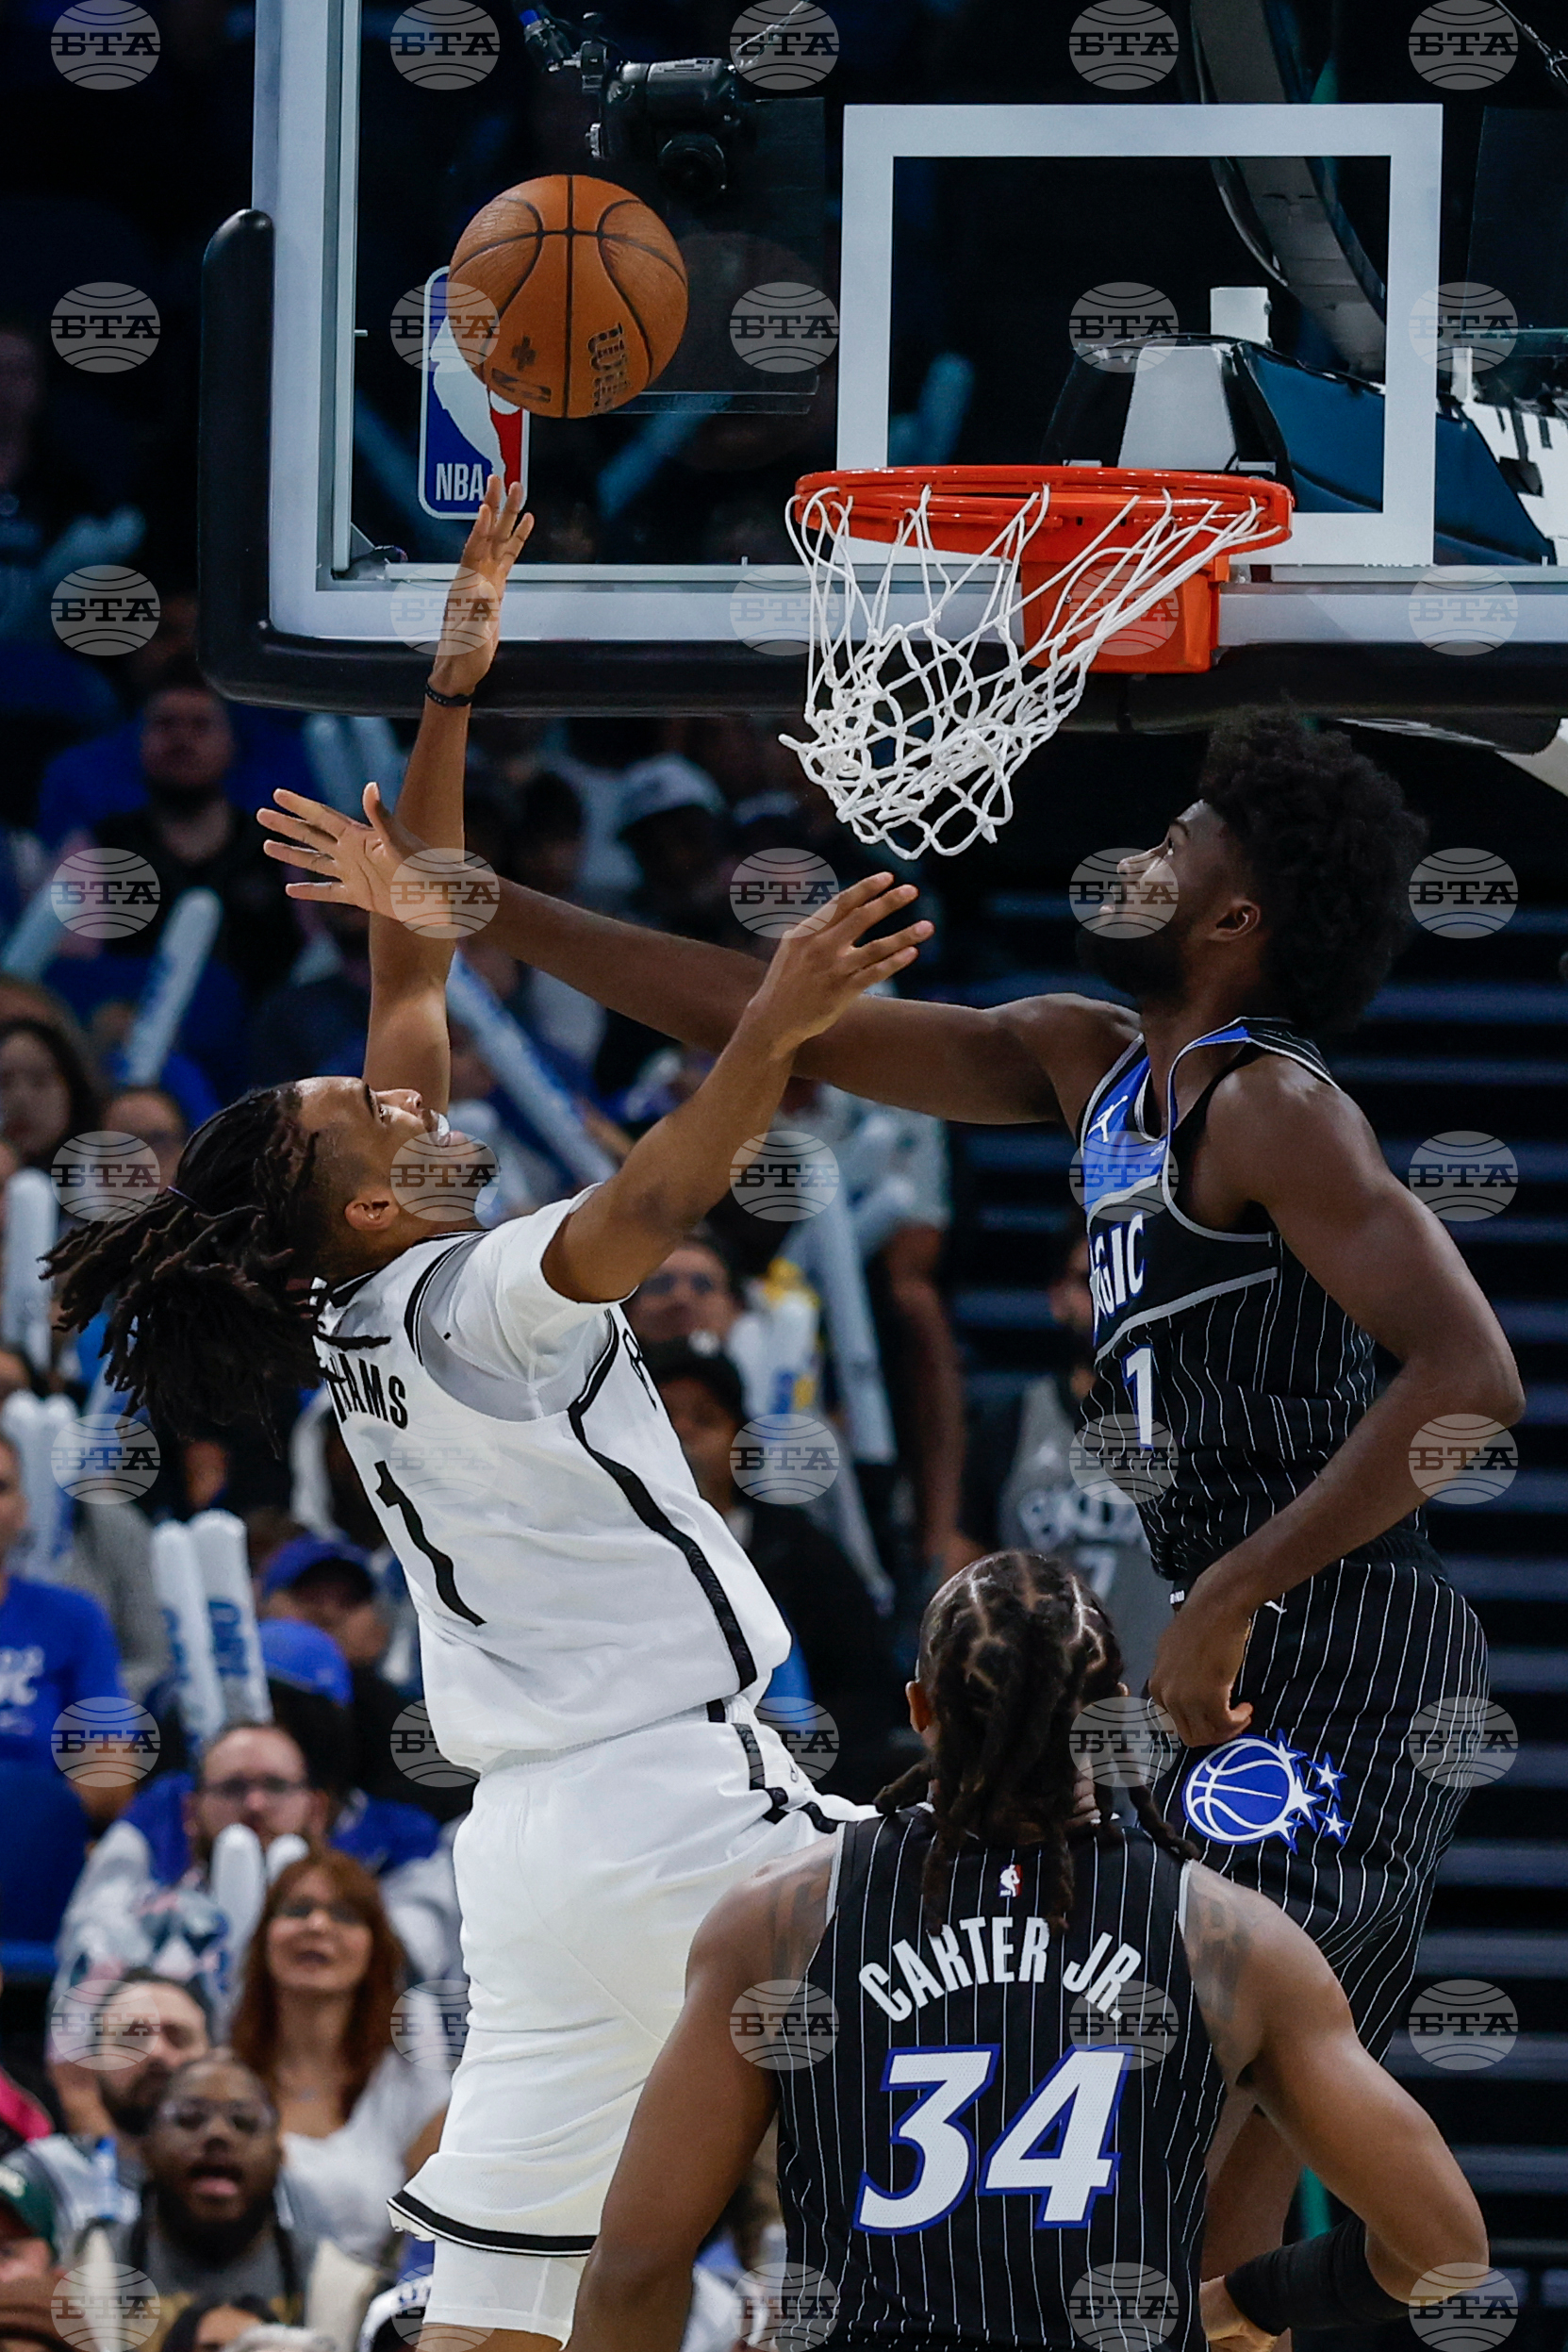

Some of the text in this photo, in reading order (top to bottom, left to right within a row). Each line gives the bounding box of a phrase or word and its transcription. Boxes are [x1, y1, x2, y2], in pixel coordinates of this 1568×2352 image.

[436, 463, 485, 501] NBA
[1122, 1345, 1154, 1449] 1
[374, 1460, 487, 1627] 1
[858, 1916, 1141, 2022] CARTER JR.
[853, 2044, 1134, 2236] 34
